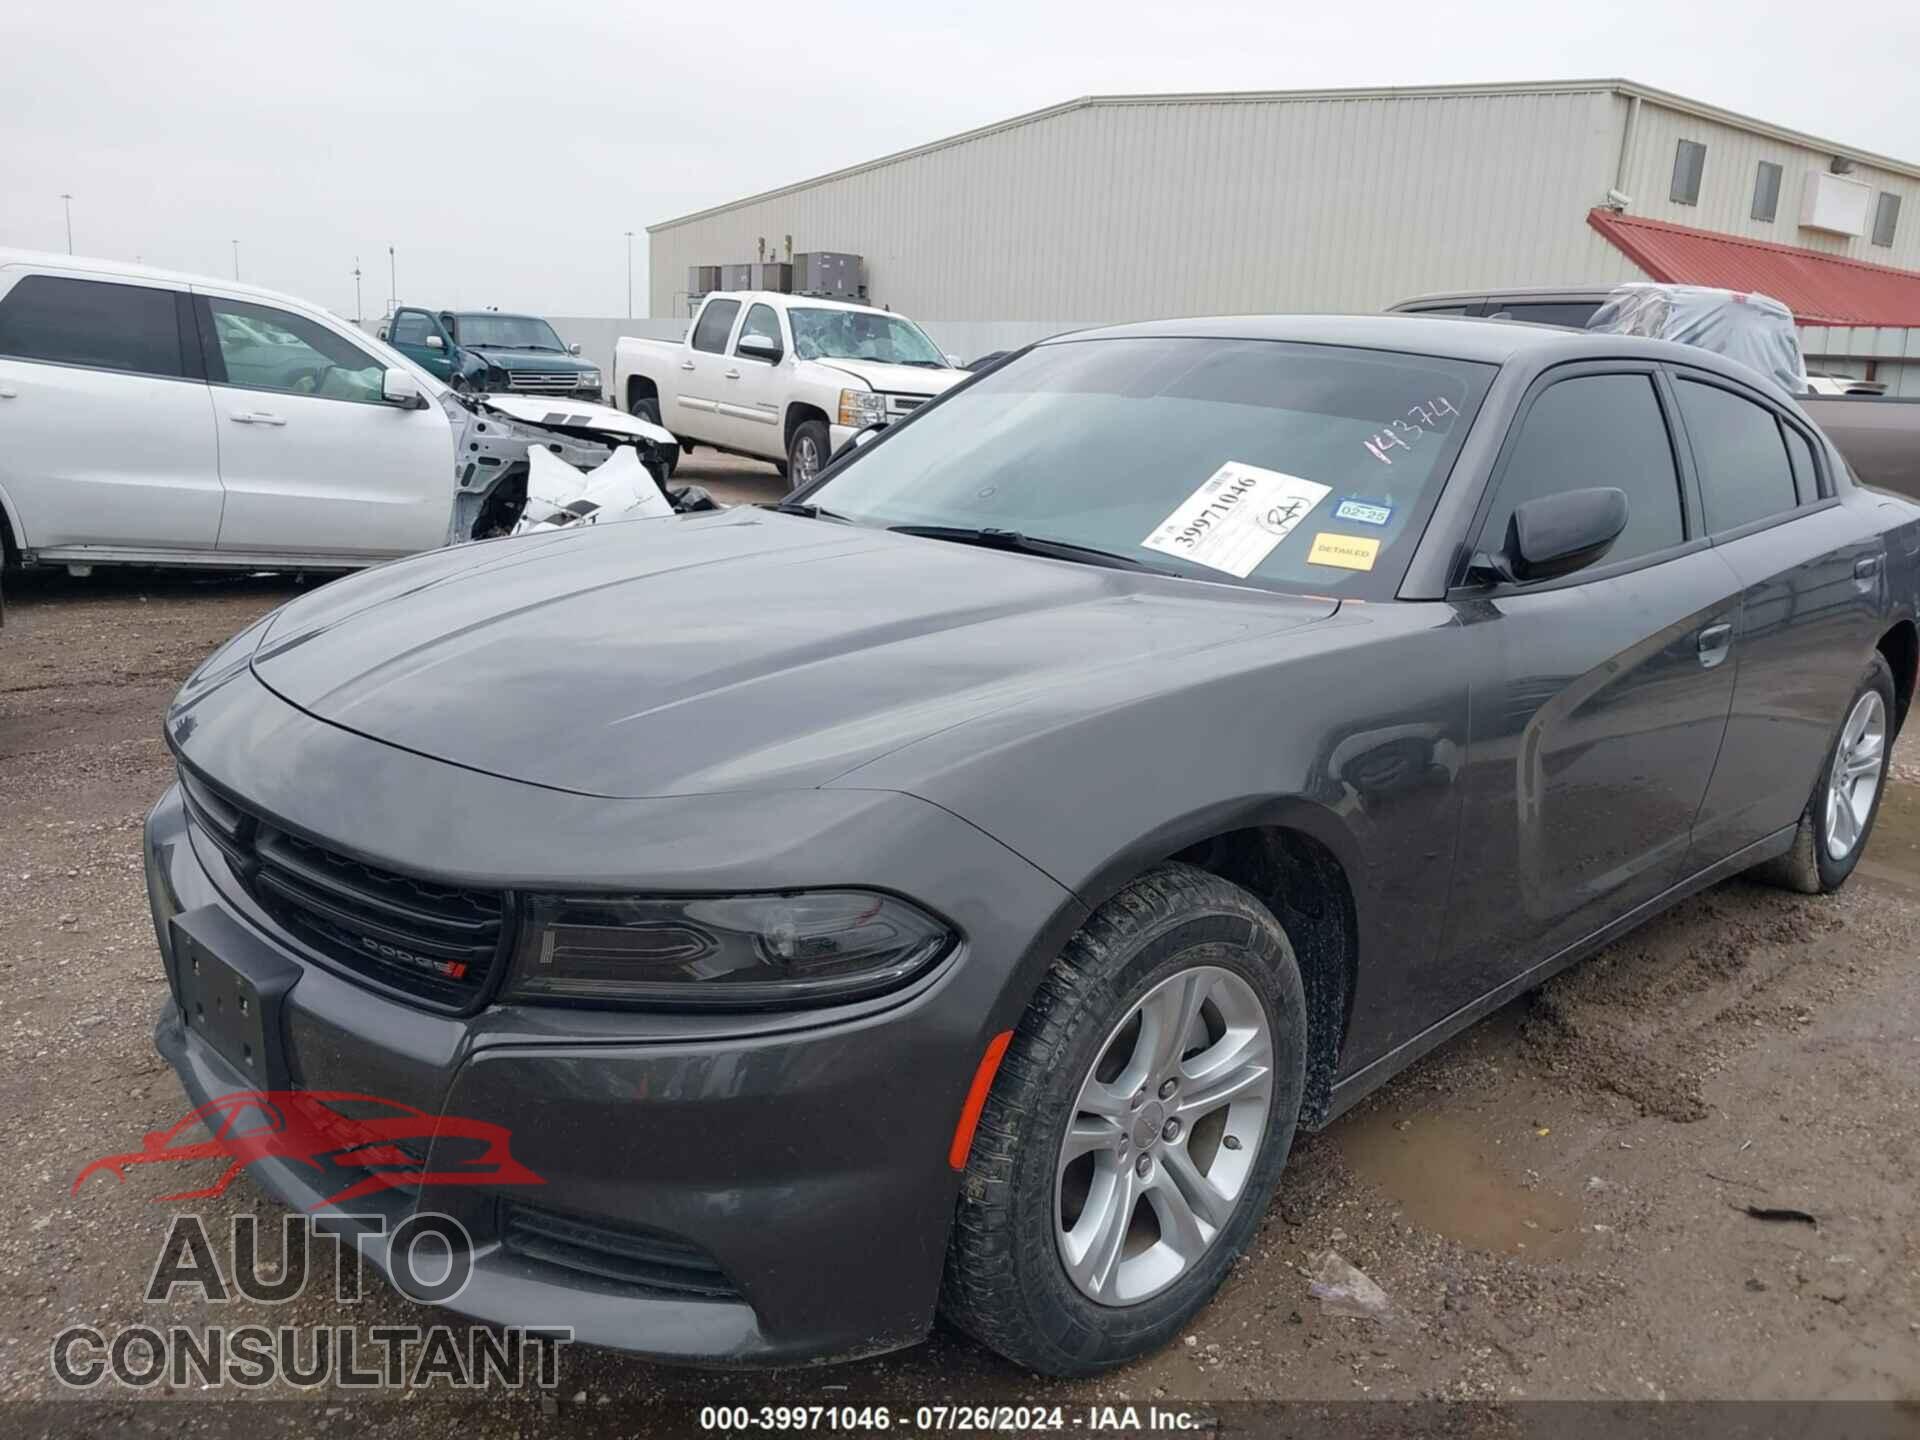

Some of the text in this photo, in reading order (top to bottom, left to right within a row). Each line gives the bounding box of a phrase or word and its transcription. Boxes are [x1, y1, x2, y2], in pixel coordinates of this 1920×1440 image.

[1174, 477, 1256, 548] 39971046
[1318, 543, 1370, 558] DETAILED
[362, 937, 450, 974] DODGE
